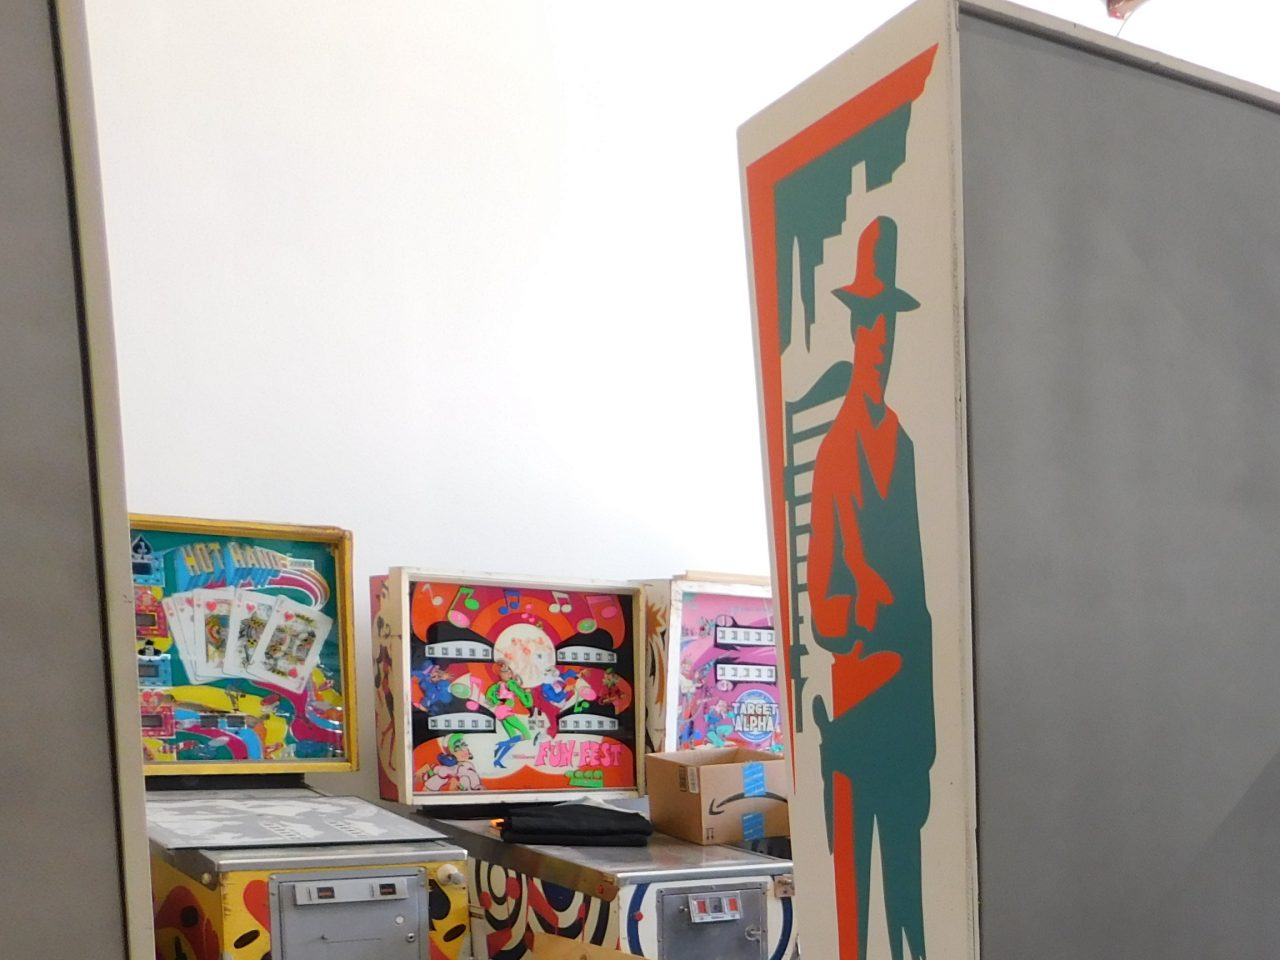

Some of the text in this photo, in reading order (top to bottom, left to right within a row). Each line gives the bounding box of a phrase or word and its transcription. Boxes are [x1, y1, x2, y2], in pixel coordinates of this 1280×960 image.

[182, 542, 225, 576] HOT
[732, 702, 778, 715] TARGET
[735, 714, 774, 732] ALPHA
[535, 739, 622, 768] FUN-FEST
